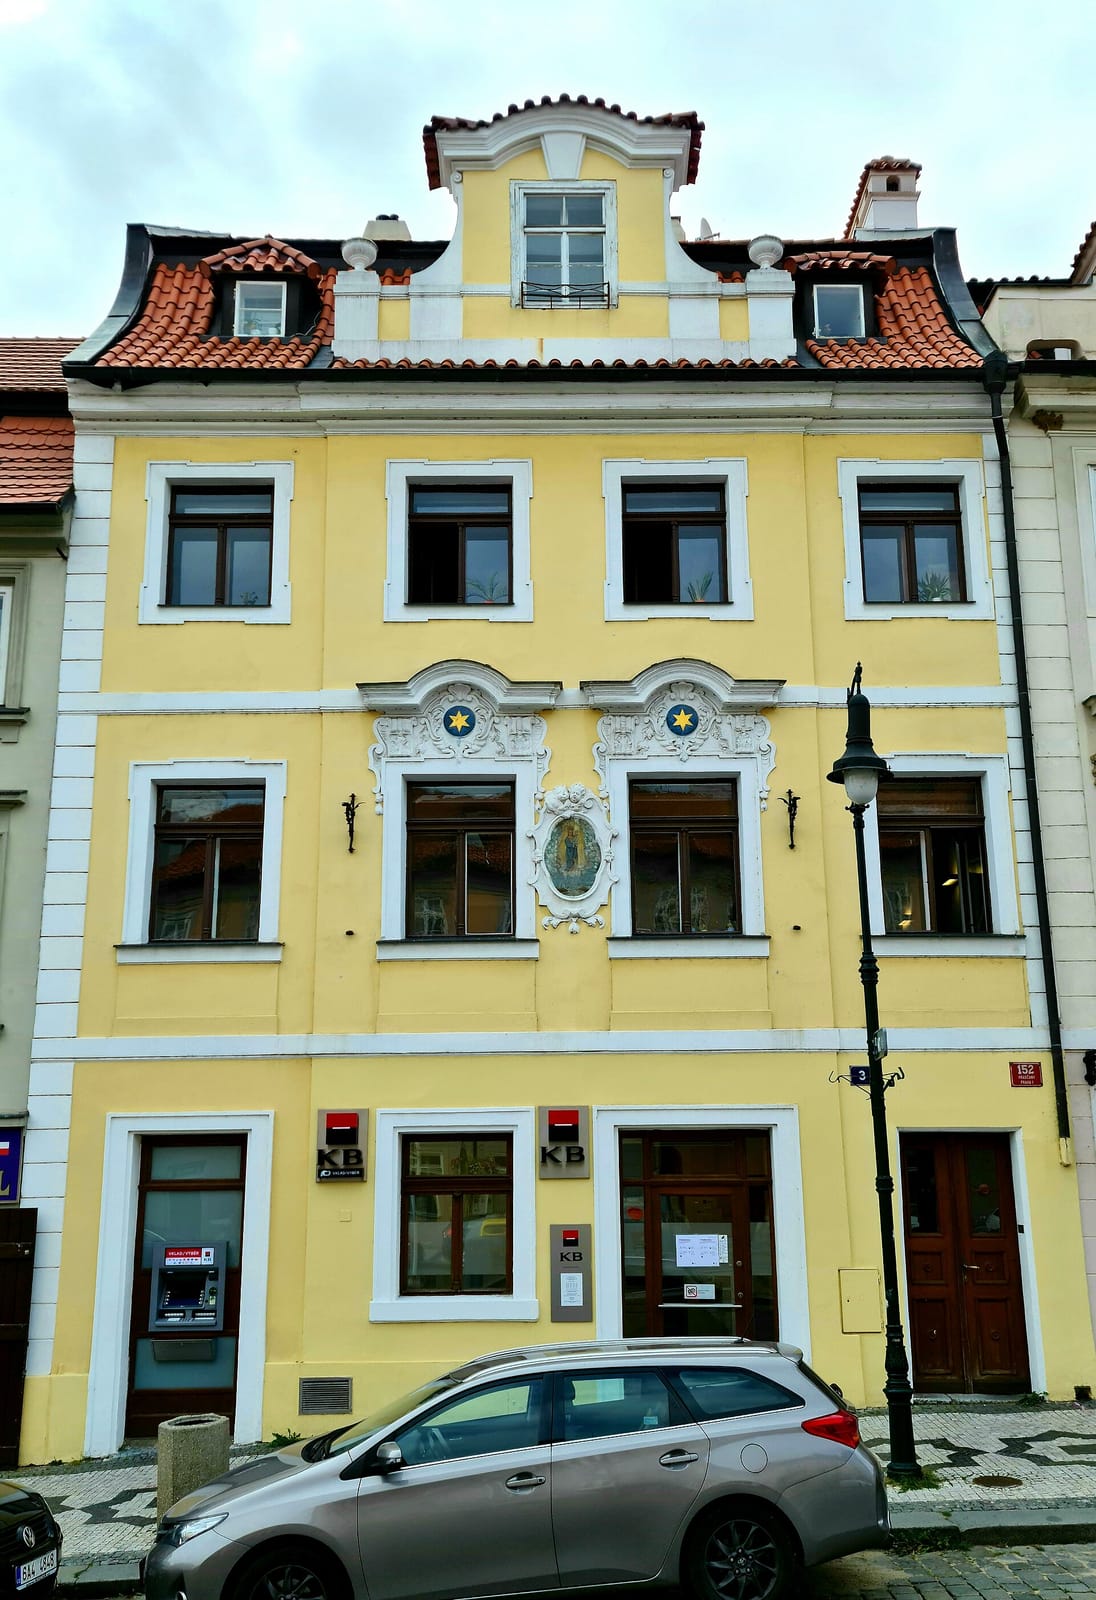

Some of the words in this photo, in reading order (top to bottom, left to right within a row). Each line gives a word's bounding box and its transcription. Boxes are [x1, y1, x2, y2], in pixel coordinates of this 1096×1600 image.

[1017, 1064, 1035, 1075] 152
[858, 1070, 866, 1081] 3
[317, 1149, 364, 1166] KB
[540, 1146, 585, 1164] KB
[560, 1252, 583, 1262] KB
